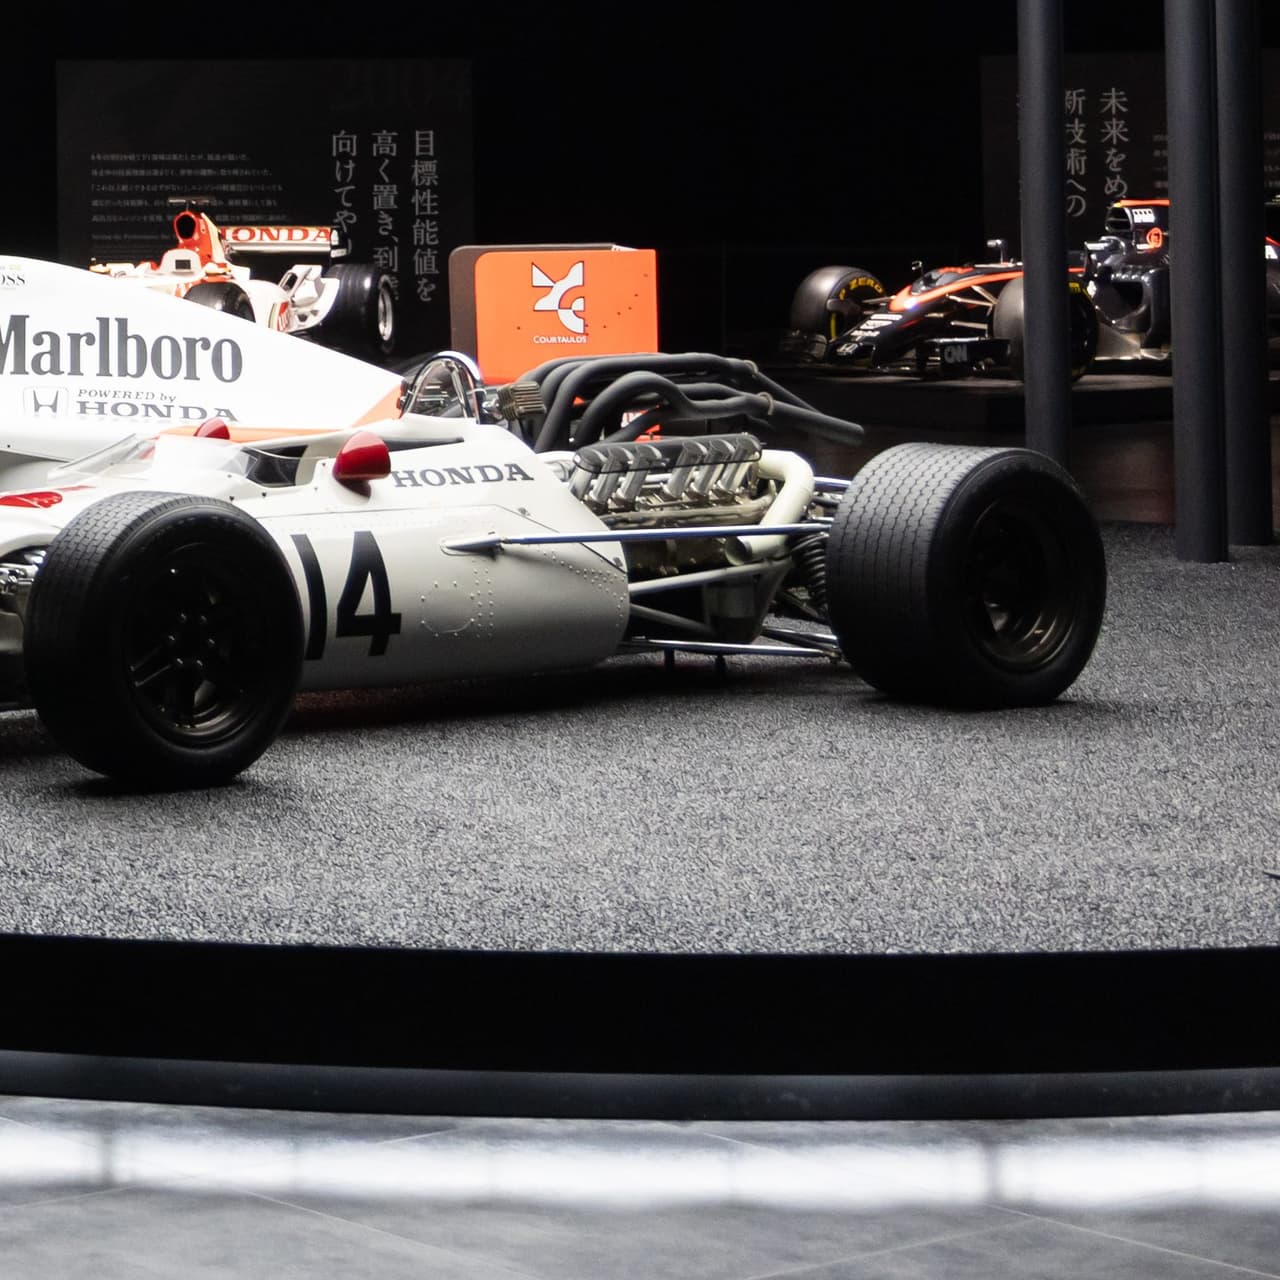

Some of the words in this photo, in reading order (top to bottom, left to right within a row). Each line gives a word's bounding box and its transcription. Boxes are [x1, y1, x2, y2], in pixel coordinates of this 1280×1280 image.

[1100, 87, 1129, 202] 未来をめ
[411, 130, 440, 301] 目標性能値を
[532, 335, 588, 345] COURTAULDS
[76, 388, 157, 401] POWERED
[159, 391, 177, 403] by
[76, 400, 240, 422] HONDA
[390, 463, 535, 488] HONDA
[291, 531, 402, 661] 14
